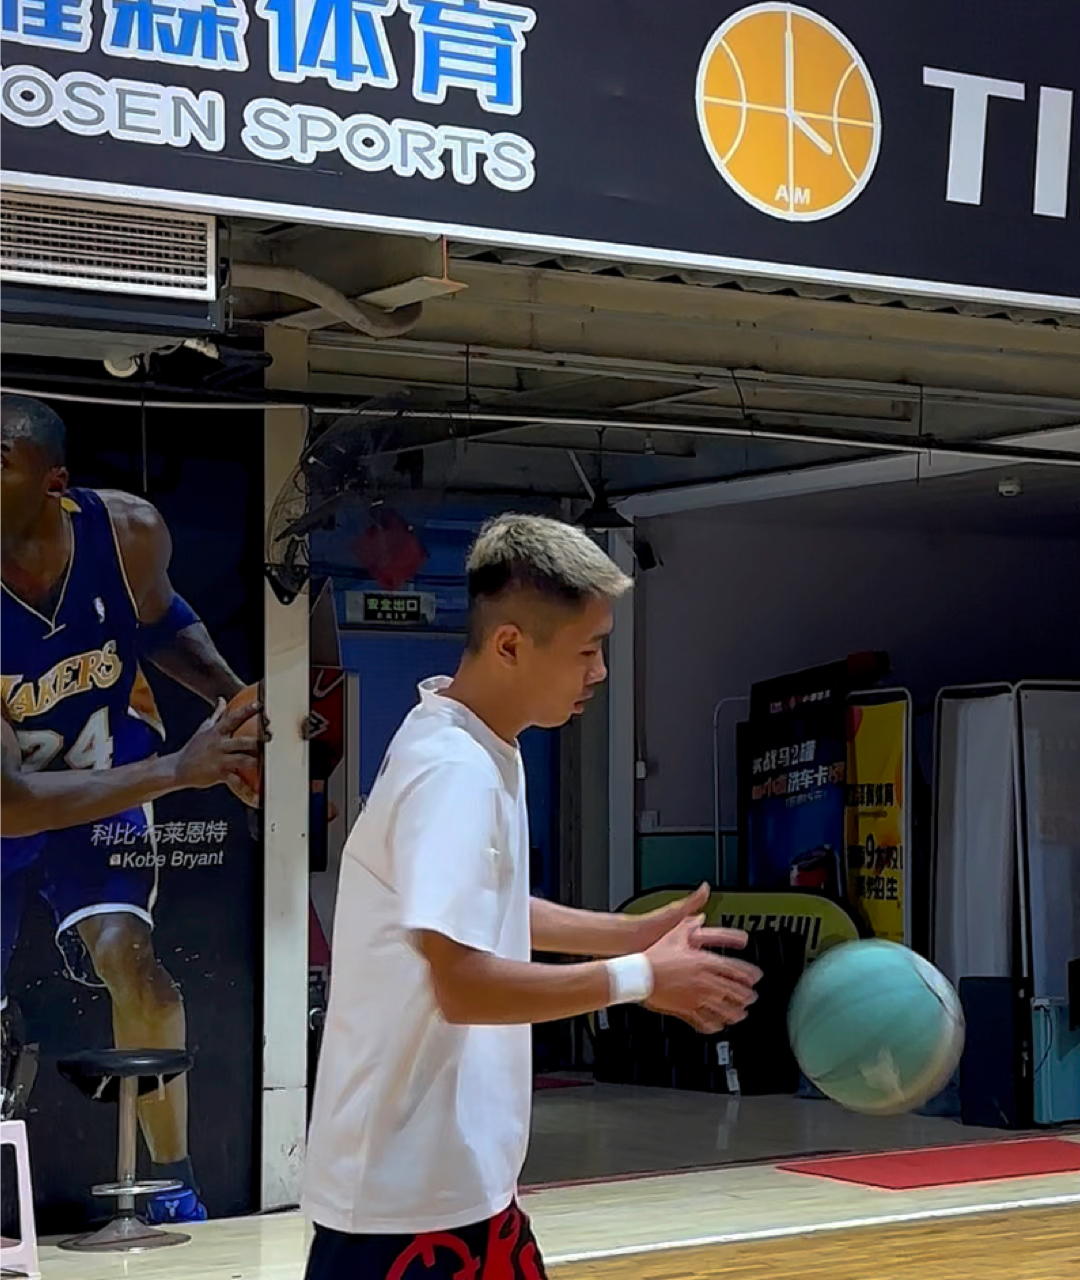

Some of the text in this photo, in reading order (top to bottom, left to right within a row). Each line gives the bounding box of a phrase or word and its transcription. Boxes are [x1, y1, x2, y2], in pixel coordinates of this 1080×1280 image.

[0, 65, 537, 191] OSEN SPORTS
[366, 598, 418, 612] 安全出口
[122, 850, 225, 870] Kobe Bryant
